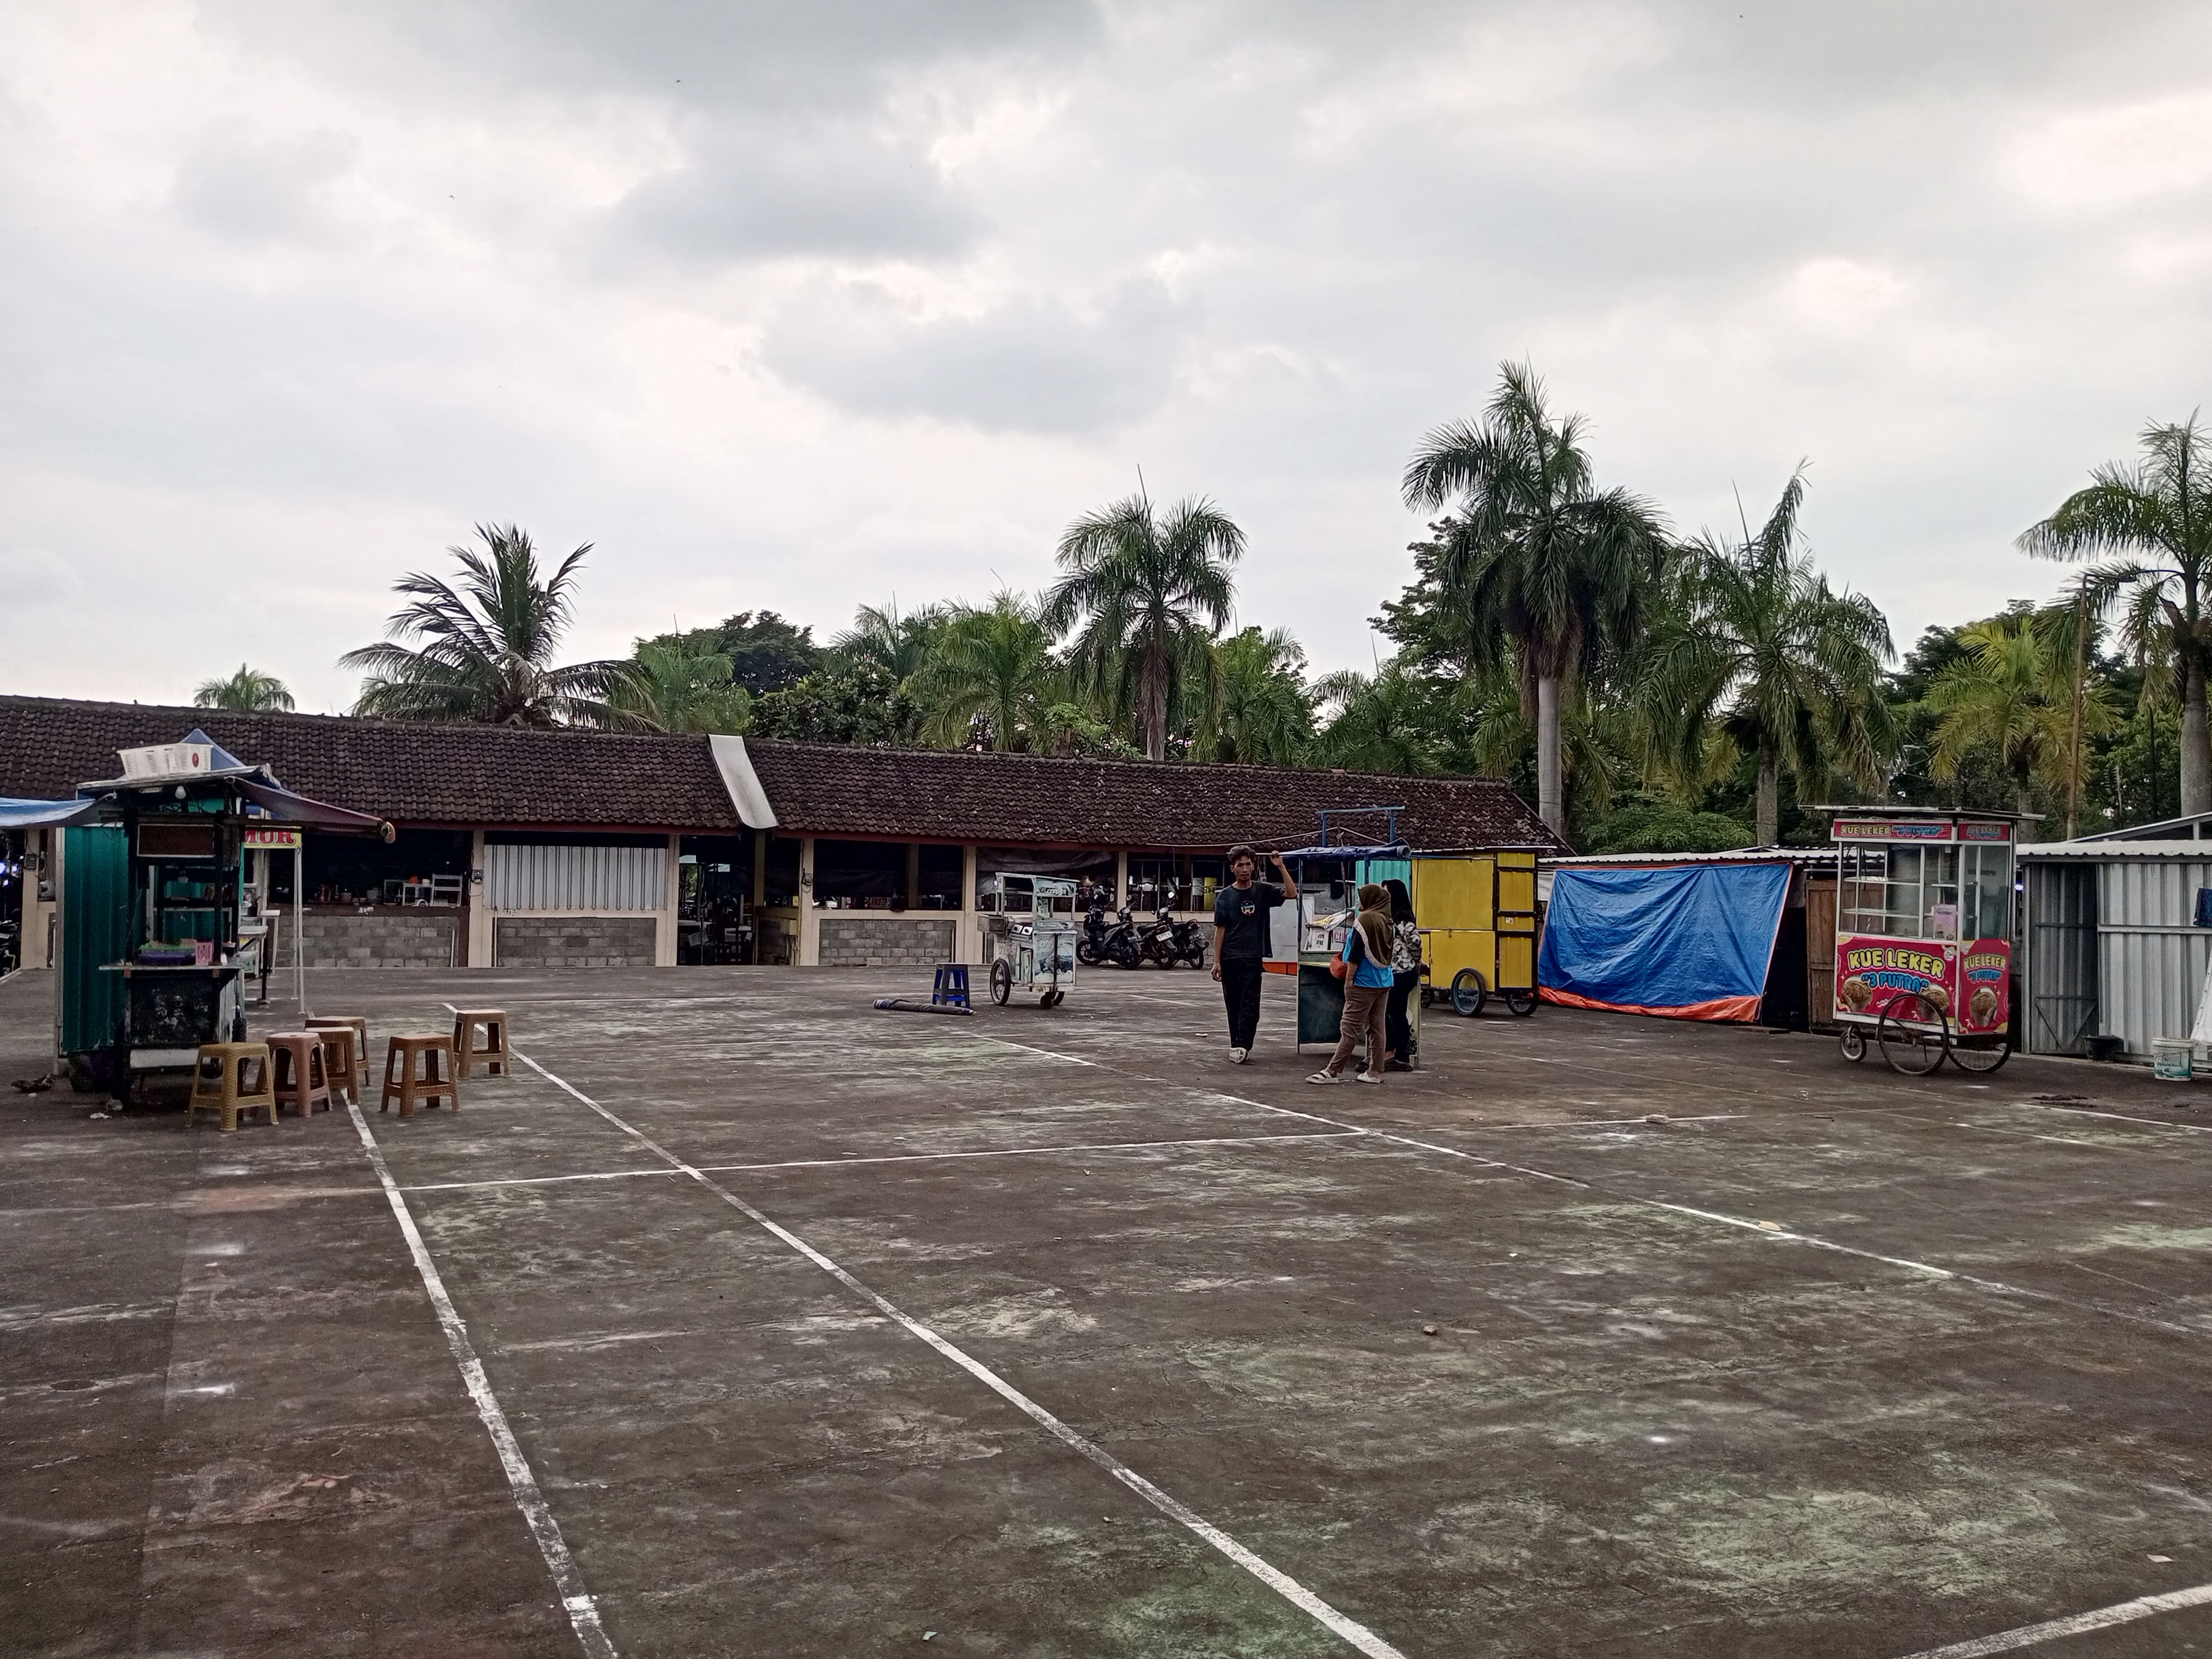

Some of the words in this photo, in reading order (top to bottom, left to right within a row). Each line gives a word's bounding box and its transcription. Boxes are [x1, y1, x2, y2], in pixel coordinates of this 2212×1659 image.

[1841, 825, 1860, 835] KUE
[1861, 825, 1891, 836] LEKER
[1848, 949, 1884, 969] KUE
[1886, 949, 1945, 979] LEKER
[1963, 956, 1981, 972] KUE
[1981, 955, 2006, 970] LEKER
